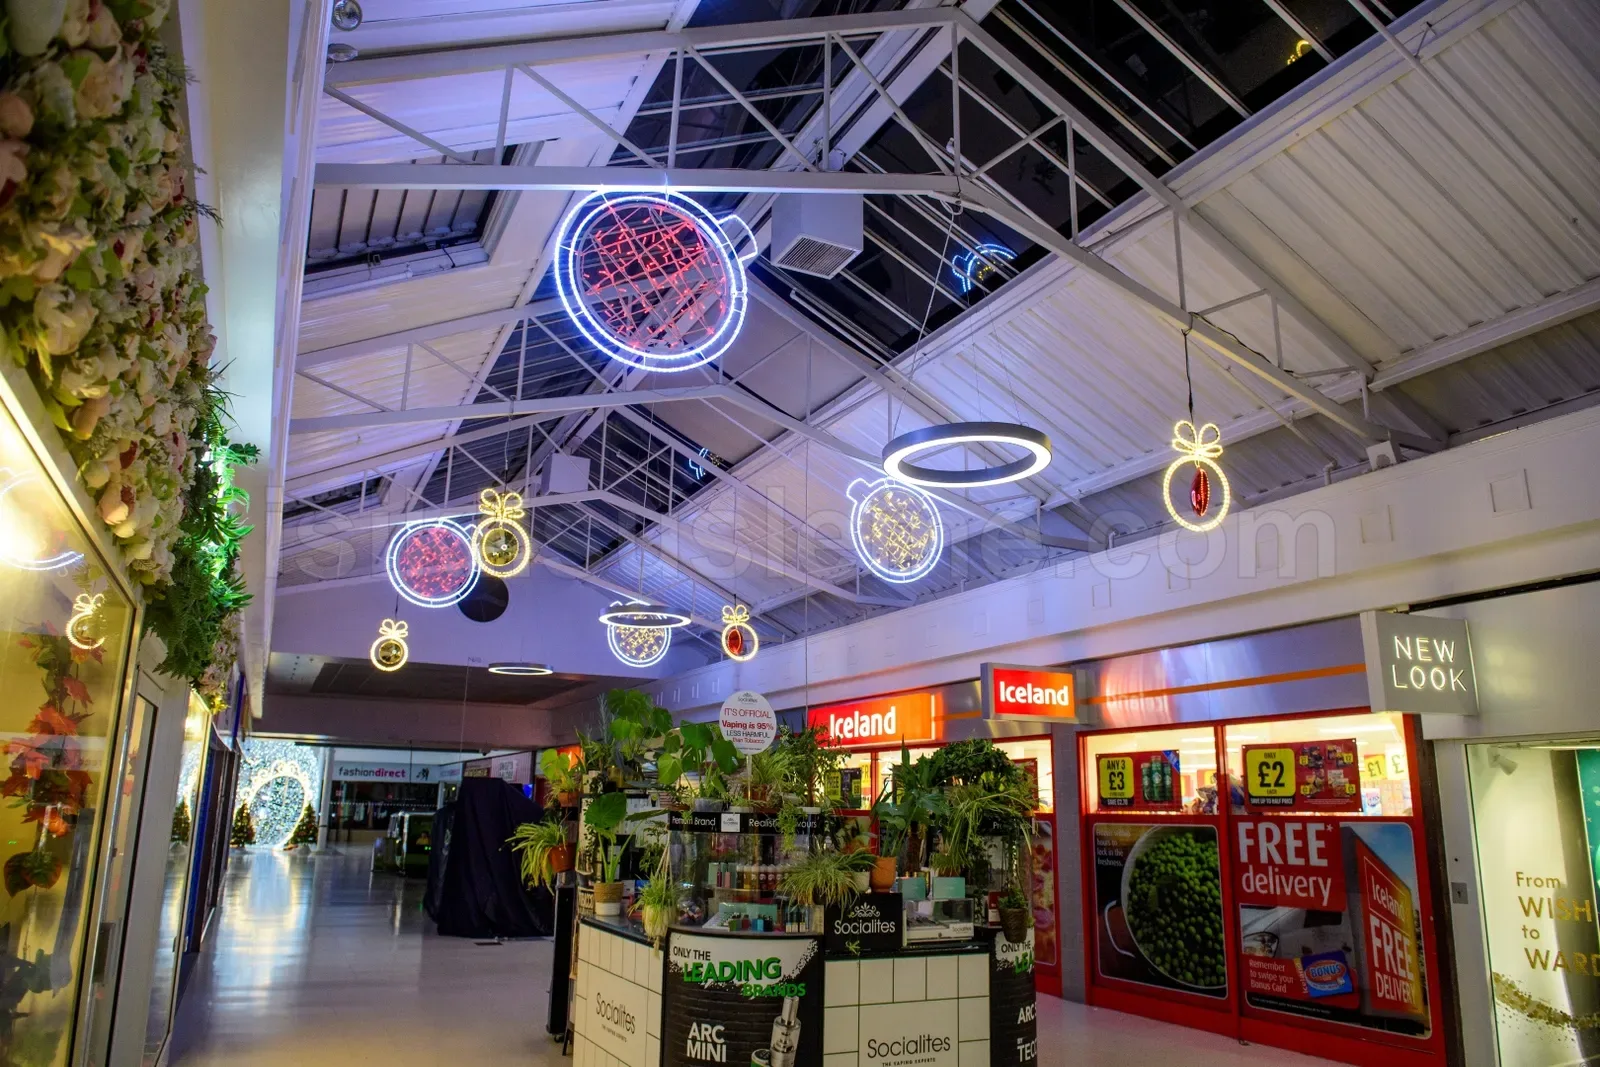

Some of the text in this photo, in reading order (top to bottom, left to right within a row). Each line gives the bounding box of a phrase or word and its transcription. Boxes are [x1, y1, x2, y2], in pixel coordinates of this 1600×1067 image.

[1392, 635, 1456, 664] NEW
[1392, 663, 1468, 692] LOOK
[999, 680, 1069, 706] Iceland
[724, 707, 772, 719] IT'S OFFICIAL
[721, 719, 774, 731] Vaping is 95%
[829, 705, 897, 739] Iceland
[742, 731, 771, 739] HARMFUL
[338, 766, 406, 778] fashiondirect
[1106, 759, 1126, 770] ANY 3
[1367, 760, 1382, 777] £1
[1108, 771, 1125, 790] £3
[1258, 760, 1285, 788] £2
[694, 817, 716, 826] Brand
[1241, 865, 1332, 907] delivery
[1516, 871, 1561, 888] From
[1518, 895, 1593, 923] WISH
[834, 918, 896, 935] Socialites
[1521, 924, 1540, 940] to
[672, 945, 711, 961] ONLY THE
[1369, 914, 1415, 981] FREE
[683, 956, 783, 983] LEADING
[1248, 959, 1286, 972] Remember
[1310, 963, 1341, 978] BONUS
[1249, 969, 1294, 985] to swipe your
[742, 983, 807, 998] BRANDS
[1250, 979, 1287, 993] Bonus Card
[1374, 971, 1416, 1005] DELIVERY
[595, 992, 636, 1035] Socialites
[688, 1021, 725, 1044] ARC
[686, 1038, 727, 1063] MINI
[867, 1034, 951, 1059] Socialites
